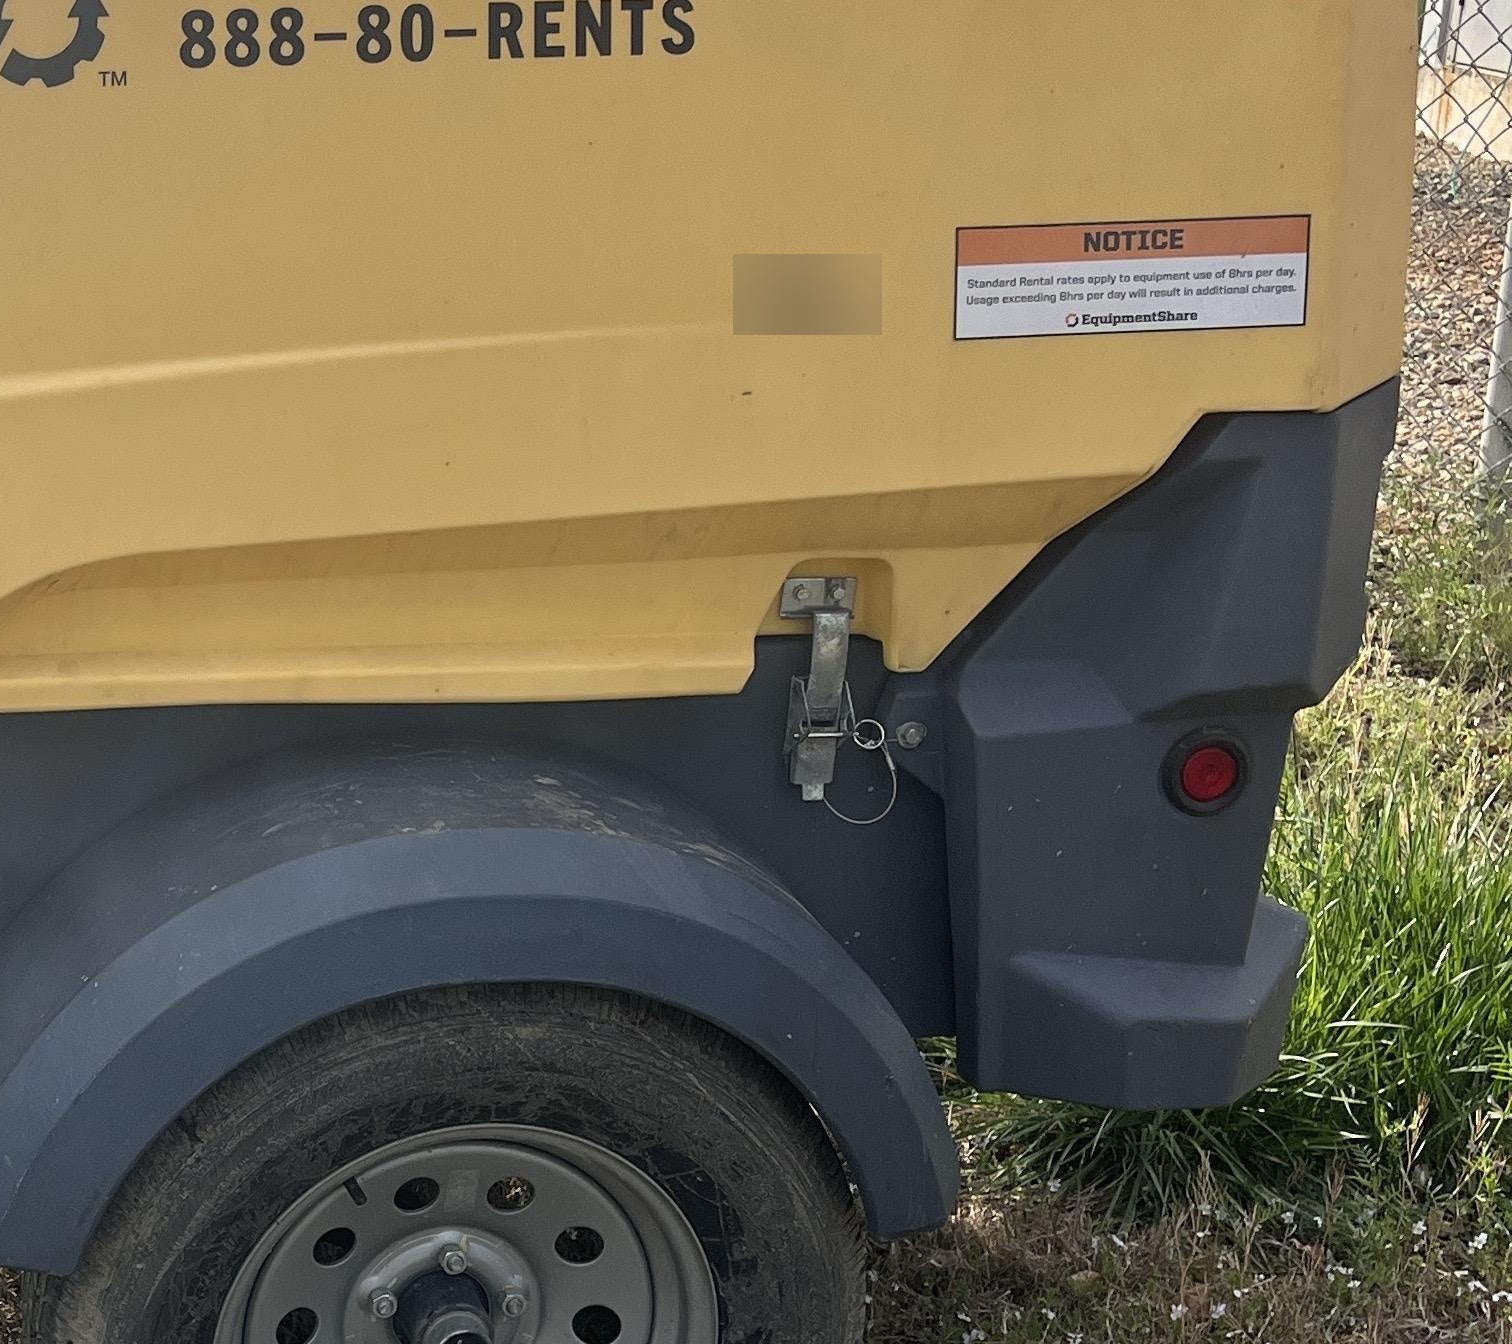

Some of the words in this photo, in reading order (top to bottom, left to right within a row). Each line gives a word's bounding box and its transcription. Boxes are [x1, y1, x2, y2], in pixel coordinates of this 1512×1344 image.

[1083, 228, 1185, 253] NOTICE
[967, 276, 1017, 289] Standard
[1019, 275, 1054, 287] Rental
[1056, 274, 1085, 286] rates
[1087, 273, 1117, 287] apply
[1119, 273, 1131, 284] to
[1133, 271, 1191, 283] equipment
[1192, 271, 1213, 281] use
[1215, 269, 1226, 280] of
[1228, 267, 1253, 279] 8hrs
[1255, 268, 1274, 280] per
[1275, 266, 1297, 279] day.
[966, 295, 1000, 306] Usage
[1002, 292, 1057, 305] exceeding
[1059, 291, 1084, 302] 8hrs
[1086, 291, 1104, 303] per
[1106, 289, 1126, 301] day
[1128, 288, 1147, 299] will
[1149, 287, 1182, 298] result
[1183, 286, 1194, 297] in
[1195, 284, 1249, 296] additional
[1251, 282, 1297, 296] charges.
[1081, 309, 1198, 327] EquipmentShare
